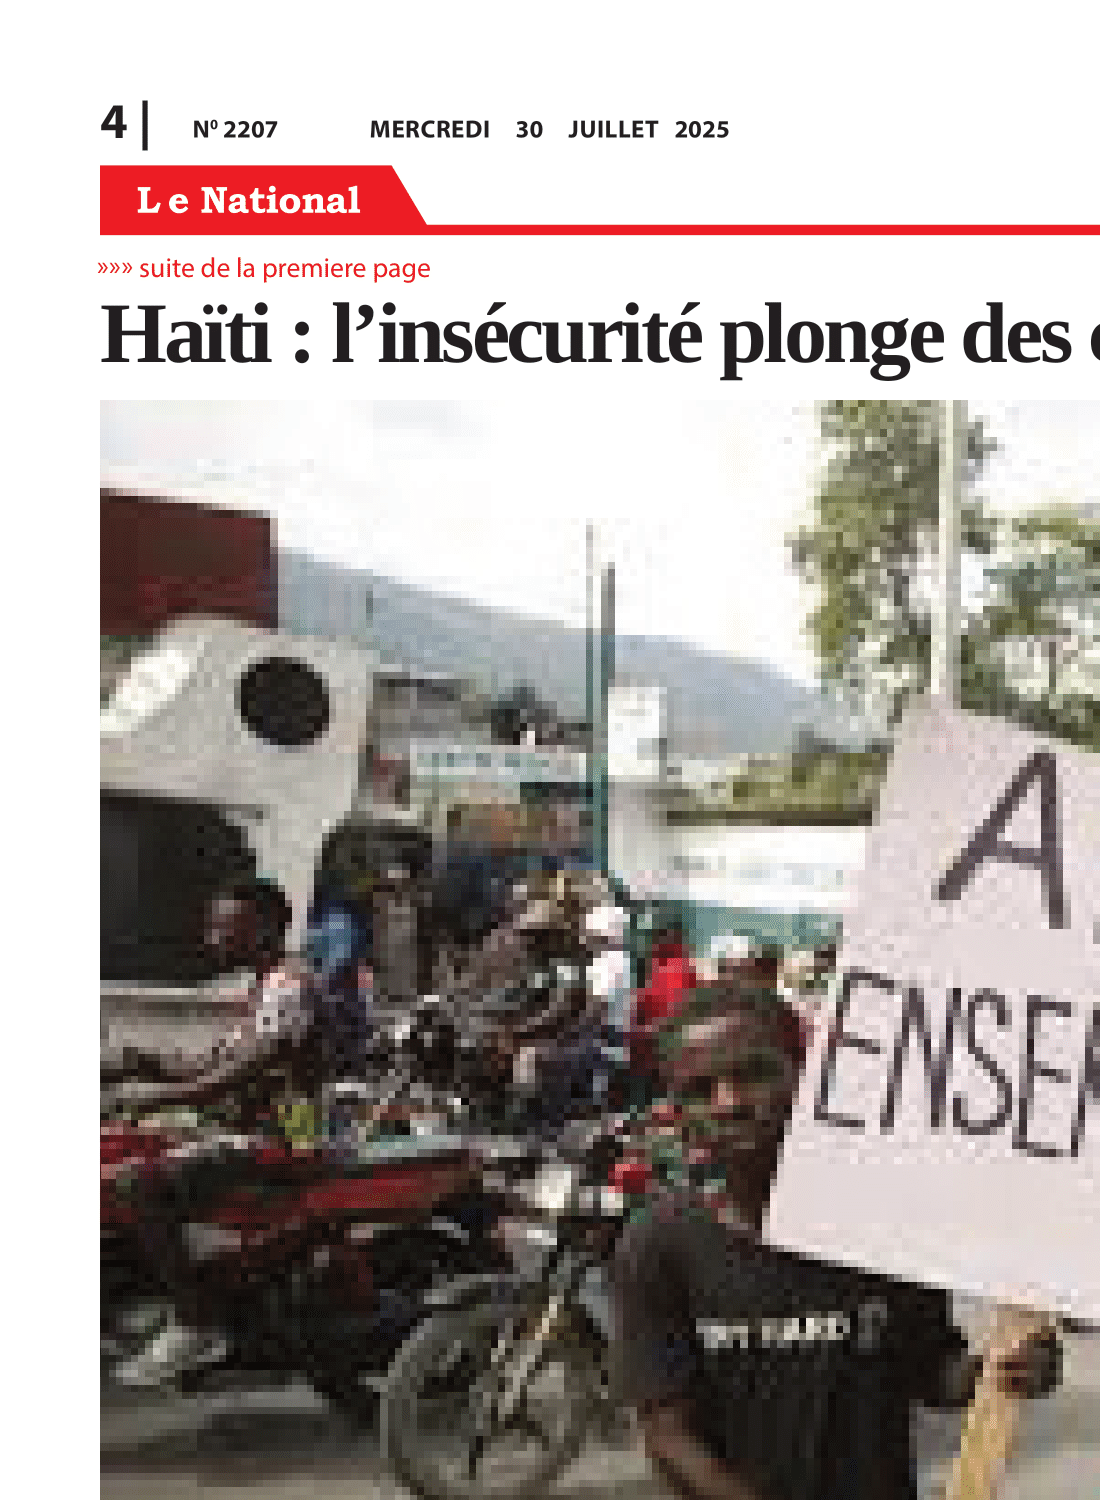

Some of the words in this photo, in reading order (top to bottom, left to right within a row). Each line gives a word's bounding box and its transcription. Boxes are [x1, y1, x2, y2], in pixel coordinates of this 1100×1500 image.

[100, 104, 128, 139] 4
[223, 120, 278, 139] 2207
[370, 119, 489, 139] MERCREDI
[516, 120, 543, 139] 30
[568, 120, 659, 139] JUILLET
[675, 120, 729, 139] 2025
[200, 185, 361, 214] National
[139, 257, 195, 278] suite
[201, 256, 230, 278] de
[237, 256, 255, 278] la
[263, 257, 366, 284] premiere
[373, 262, 431, 284] page
[101, 301, 273, 364] Haïti
[332, 301, 703, 364] l’insécurité
[719, 301, 945, 382] plonge
[963, 301, 1072, 364] des
